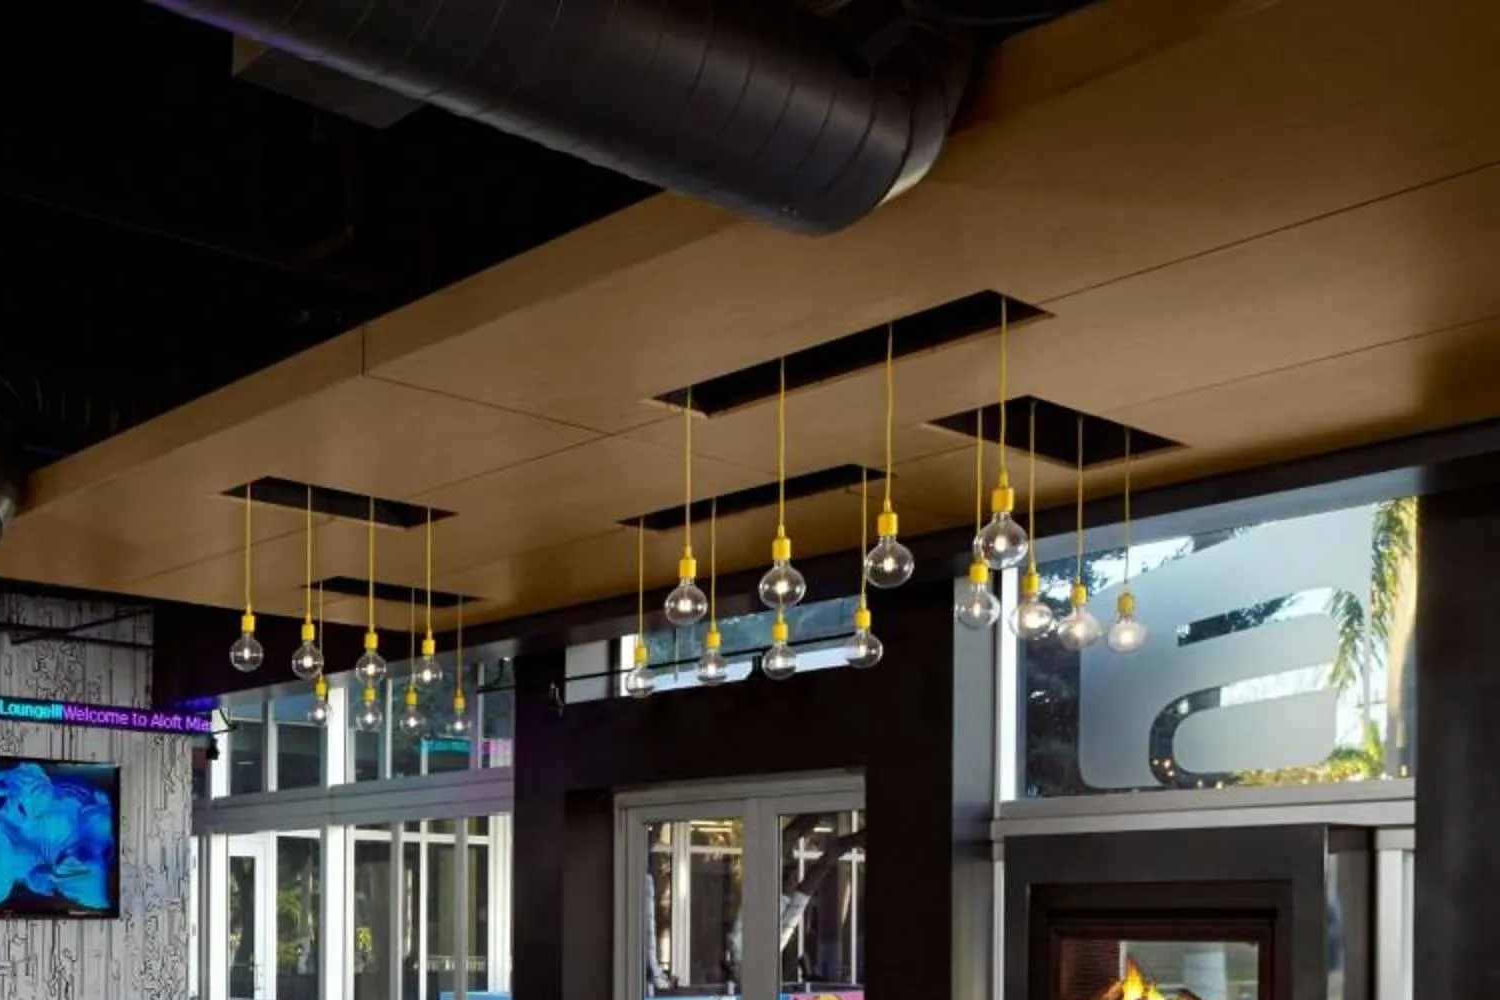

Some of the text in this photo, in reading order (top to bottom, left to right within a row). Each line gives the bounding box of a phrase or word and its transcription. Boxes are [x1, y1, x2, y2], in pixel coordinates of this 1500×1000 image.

[64, 705, 213, 732] Welcome to Aloft Mia
